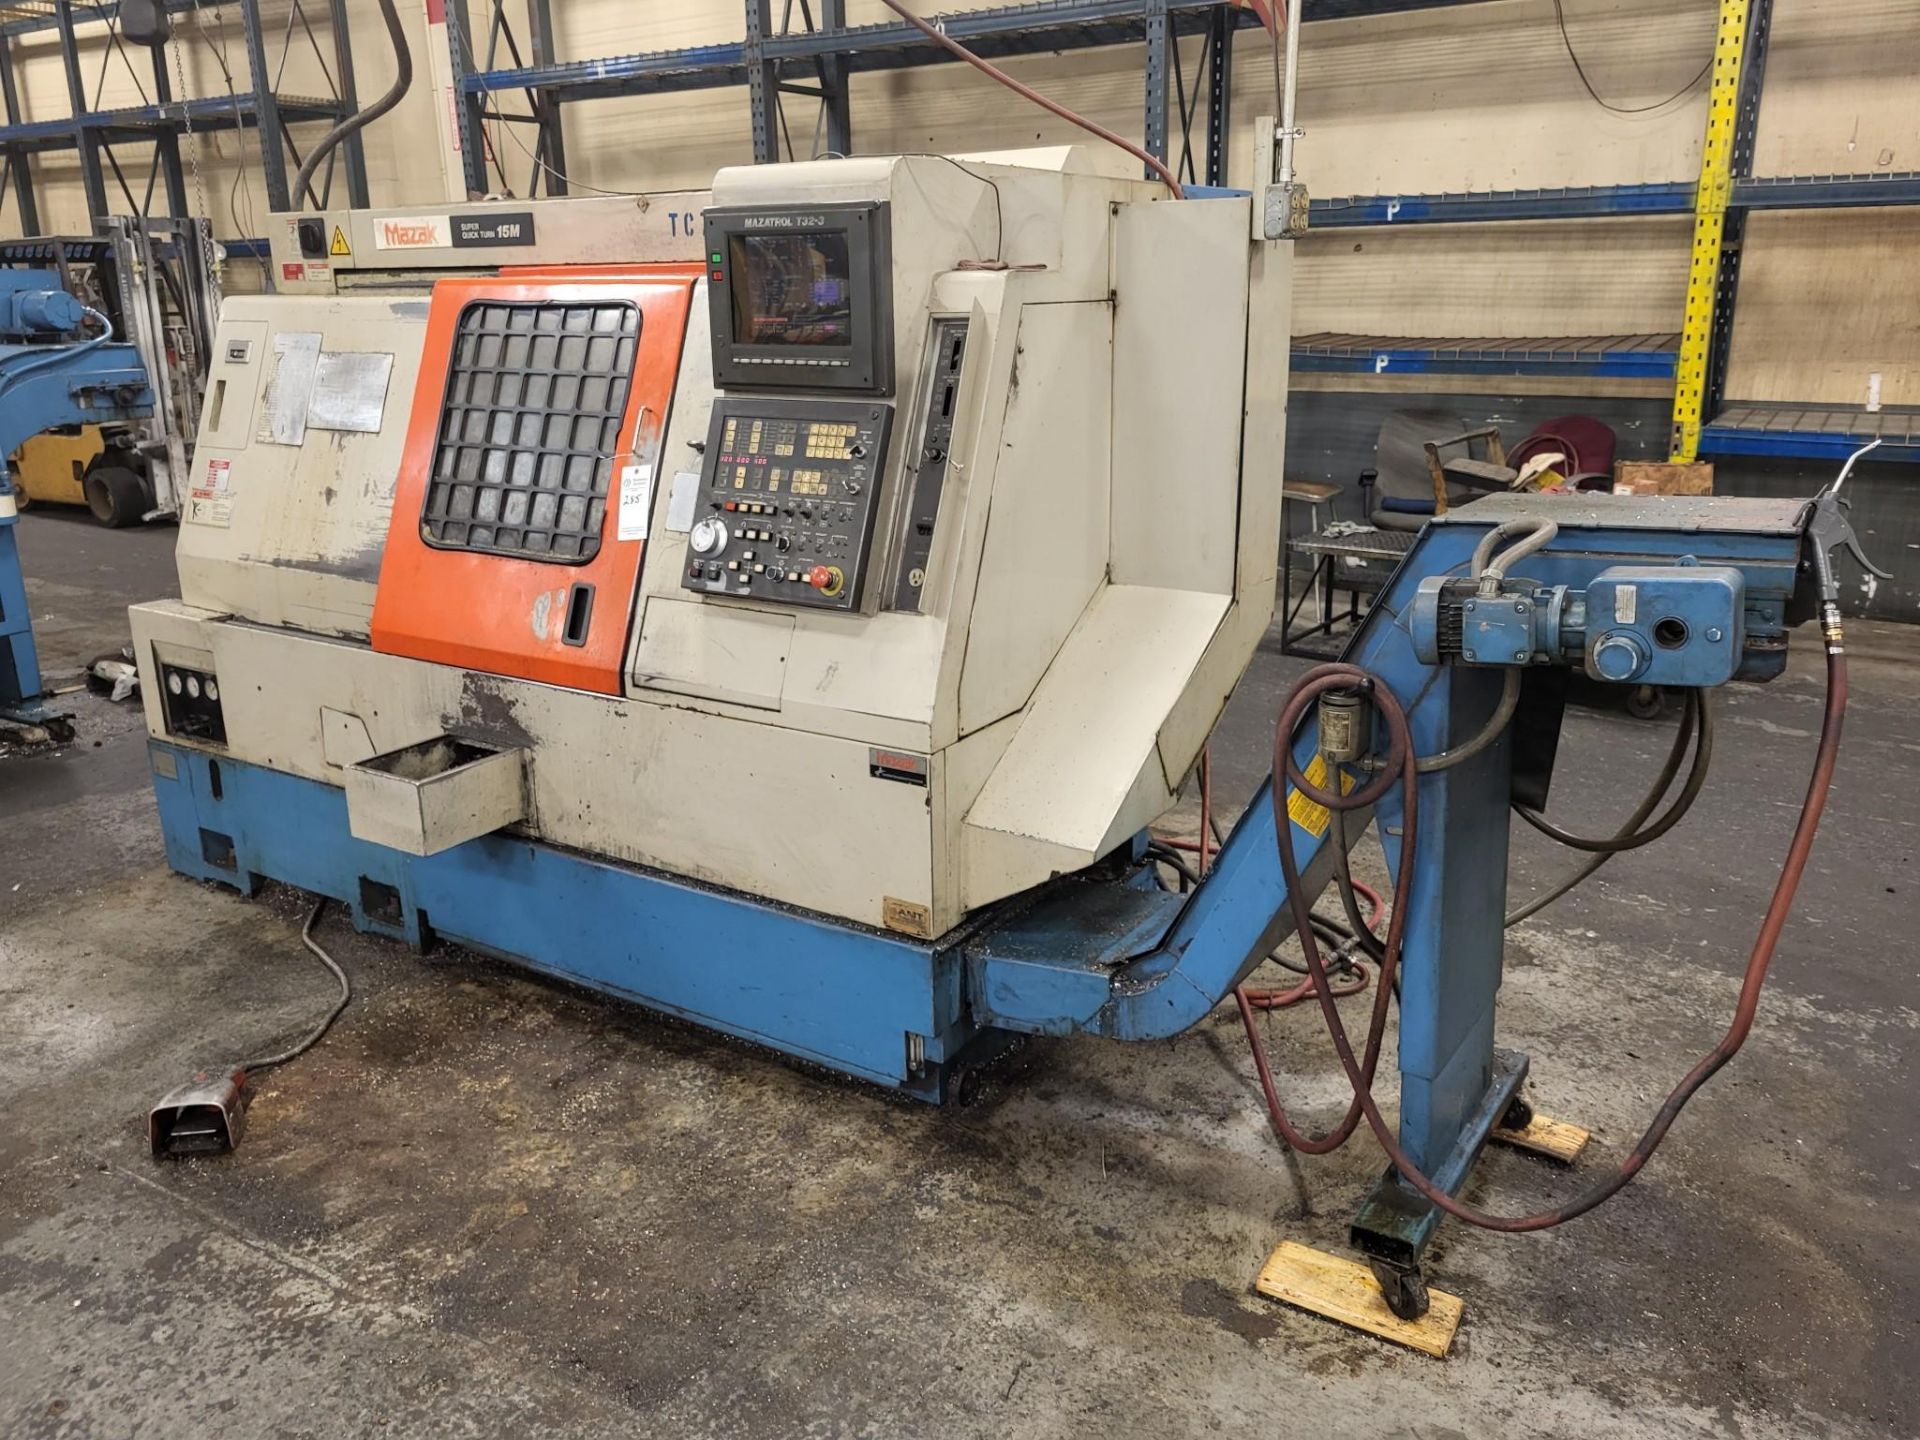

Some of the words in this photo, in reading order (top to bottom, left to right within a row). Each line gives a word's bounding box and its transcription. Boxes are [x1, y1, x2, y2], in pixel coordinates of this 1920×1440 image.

[1388, 201, 1401, 221] P
[460, 223, 480, 232] SUPER
[461, 231, 480, 240] QUICK
[480, 230, 496, 239] TURN
[496, 223, 521, 239] 15M
[668, 212, 705, 237] TC
[744, 216, 794, 229] MAZATROL
[383, 222, 438, 246] Mazak
[1375, 355, 1389, 374] P
